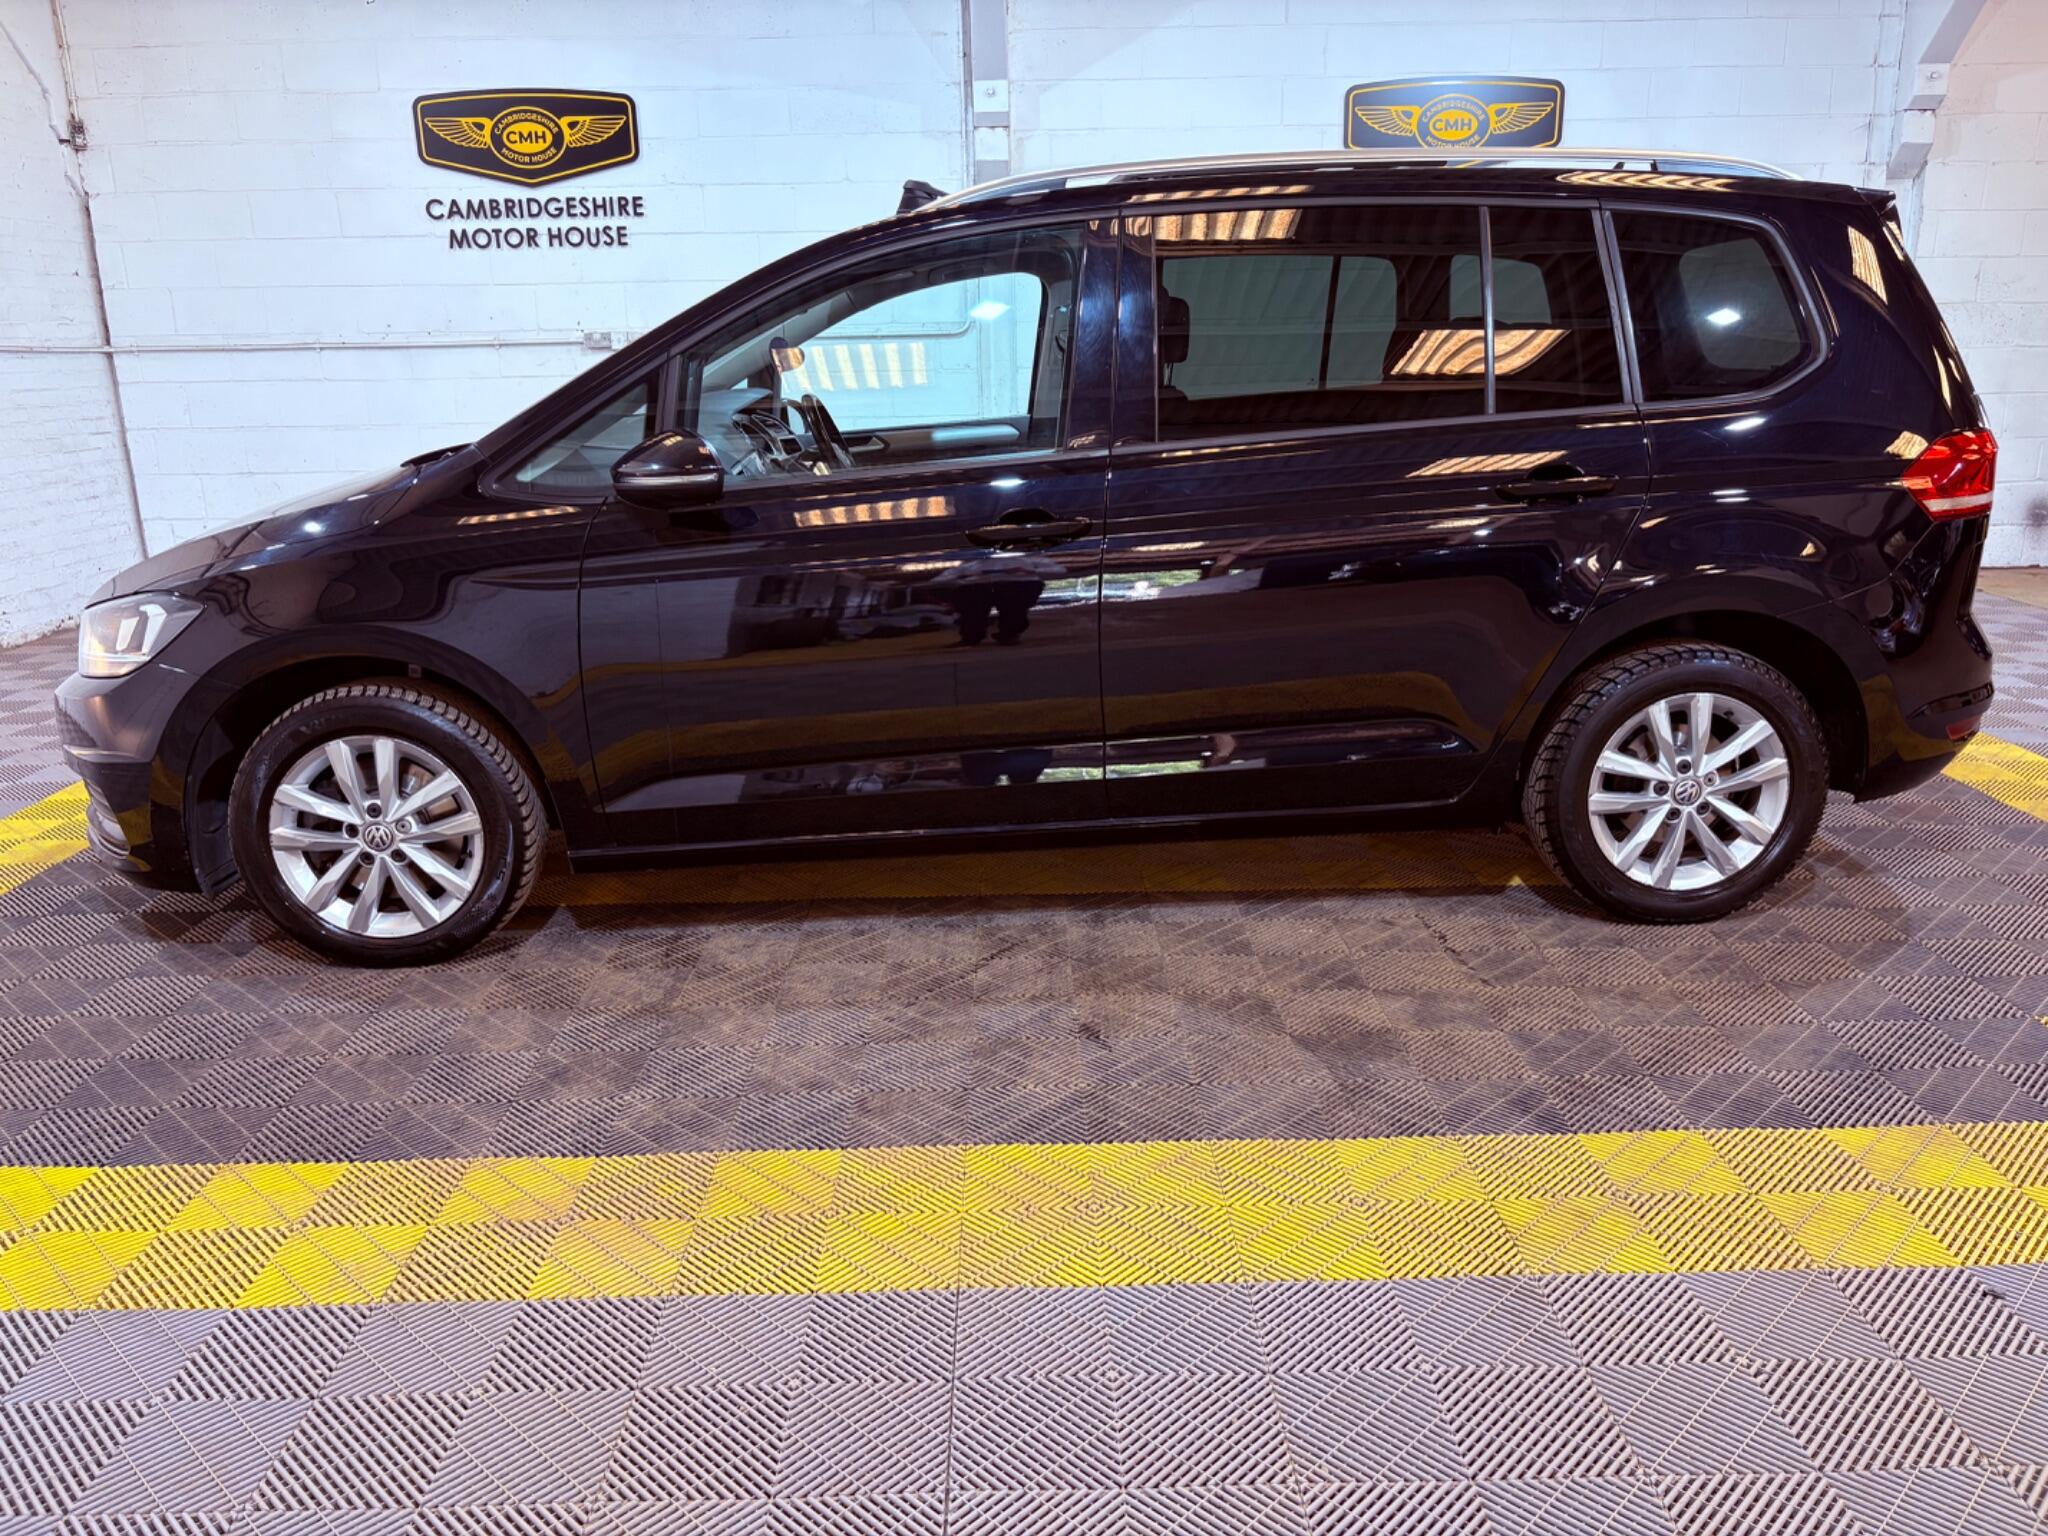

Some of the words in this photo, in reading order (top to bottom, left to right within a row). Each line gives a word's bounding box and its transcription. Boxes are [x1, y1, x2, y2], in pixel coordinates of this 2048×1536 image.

[495, 112, 559, 134] CAMBRIDGESHIRE
[1433, 118, 1473, 131] CMH
[506, 130, 547, 144] CMH
[501, 147, 530, 163] MOTOR
[531, 146, 557, 163] HOUSE
[425, 196, 645, 220] CAMBRIDGESHIRE
[449, 227, 540, 249] MOTOR
[547, 225, 629, 248] HOUSE
